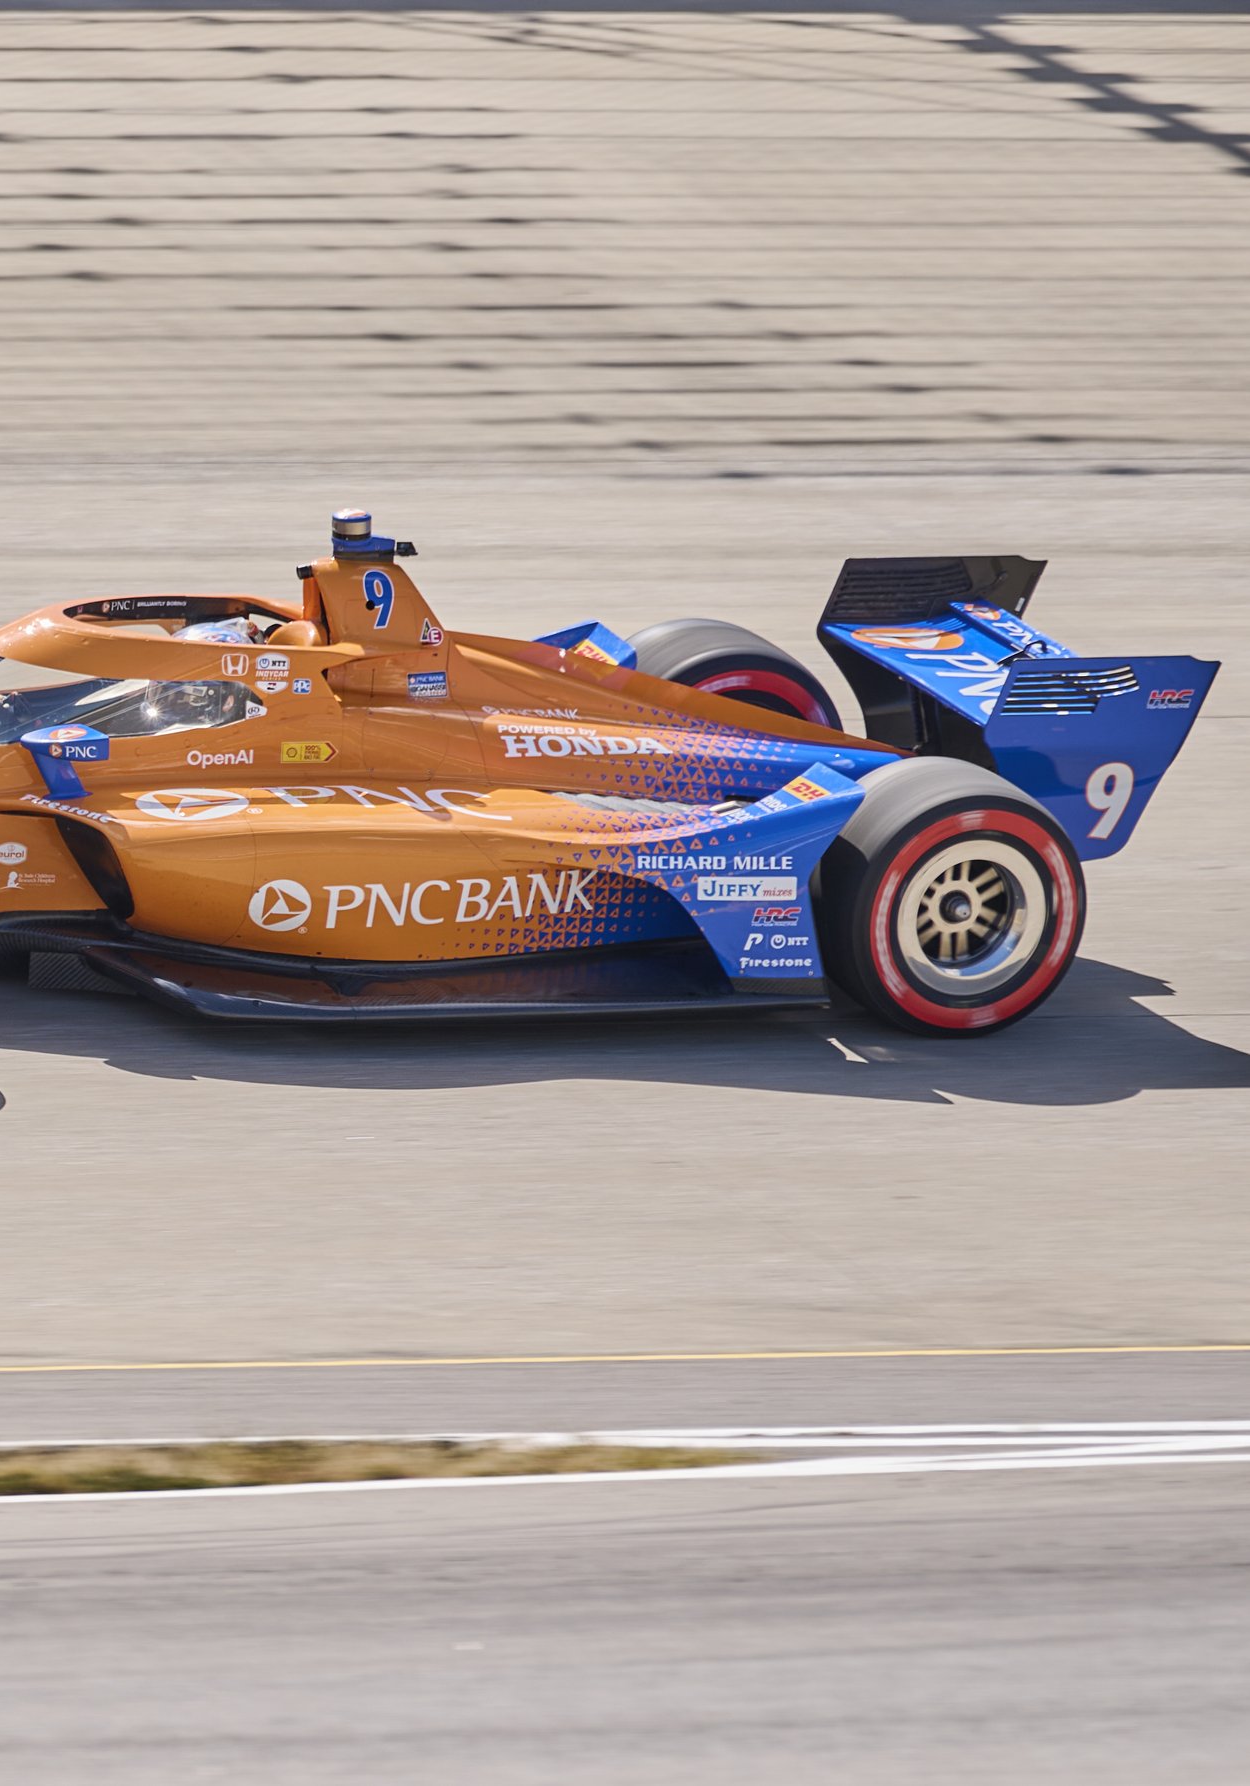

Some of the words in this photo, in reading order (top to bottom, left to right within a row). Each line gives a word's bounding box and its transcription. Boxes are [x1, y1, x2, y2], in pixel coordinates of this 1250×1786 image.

[111, 601, 131, 611] PNC
[362, 568, 395, 630] 9
[294, 681, 310, 693] PPG
[1148, 689, 1195, 706] HRC
[498, 724, 575, 735] POWERED
[578, 725, 597, 737] by
[65, 745, 97, 758] PNC
[500, 735, 674, 758] HONDA
[186, 749, 254, 769] OpenAI
[19, 793, 111, 823] Firestone
[253, 785, 513, 822] PNC
[1085, 761, 1135, 840] 9
[637, 855, 726, 871] RICHARD
[733, 855, 793, 871] MILLE
[322, 880, 451, 929] PNC
[455, 869, 599, 923] BANK
[762, 886, 793, 897] mixes
[752, 907, 802, 923] HRC
[787, 936, 809, 946] NTT
[739, 957, 812, 969] Firestone
